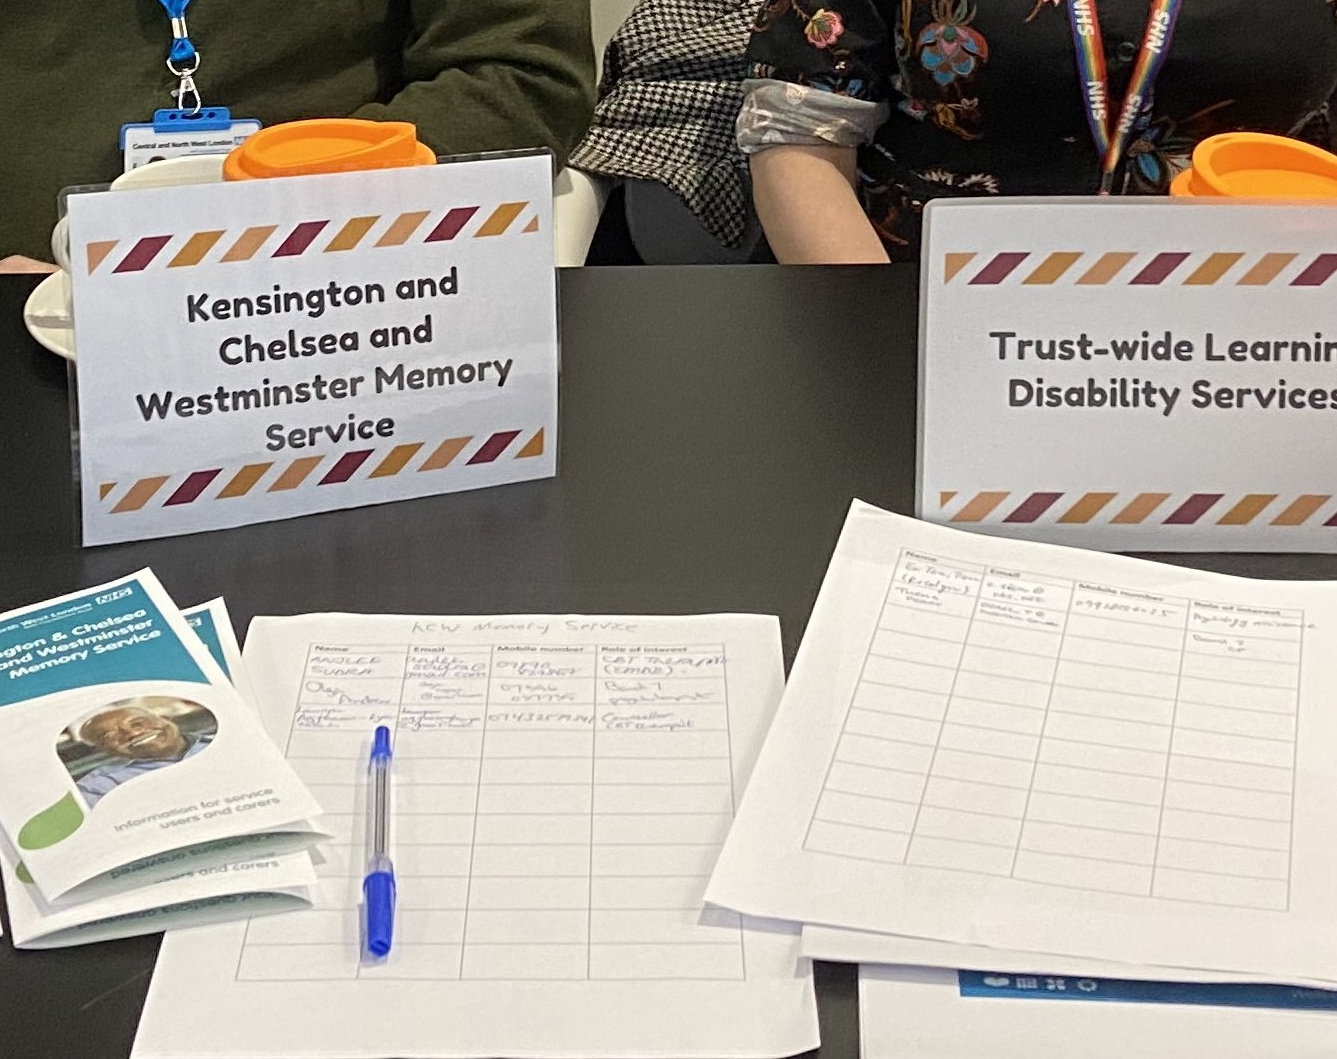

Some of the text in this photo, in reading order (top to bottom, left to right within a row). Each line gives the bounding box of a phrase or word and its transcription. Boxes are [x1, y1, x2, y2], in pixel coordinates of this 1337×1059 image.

[1145, 8, 1170, 54] NHS
[1086, 81, 1107, 121] NHS
[186, 266, 460, 323] Kensington and
[219, 315, 433, 366] Chelsea and
[989, 330, 1194, 362] Trust-wide
[135, 357, 514, 422] Westminster Memory
[1008, 377, 1181, 416] Disability
[265, 414, 395, 452] Service
[37, 618, 154, 658] Westminster
[52, 629, 69, 641] &
[72, 608, 147, 636] Chelsea
[9, 629, 162, 679] Memory Service
[114, 787, 274, 832] Information for service
[160, 797, 281, 829] users and carers
[198, 859, 280, 875] and carers
